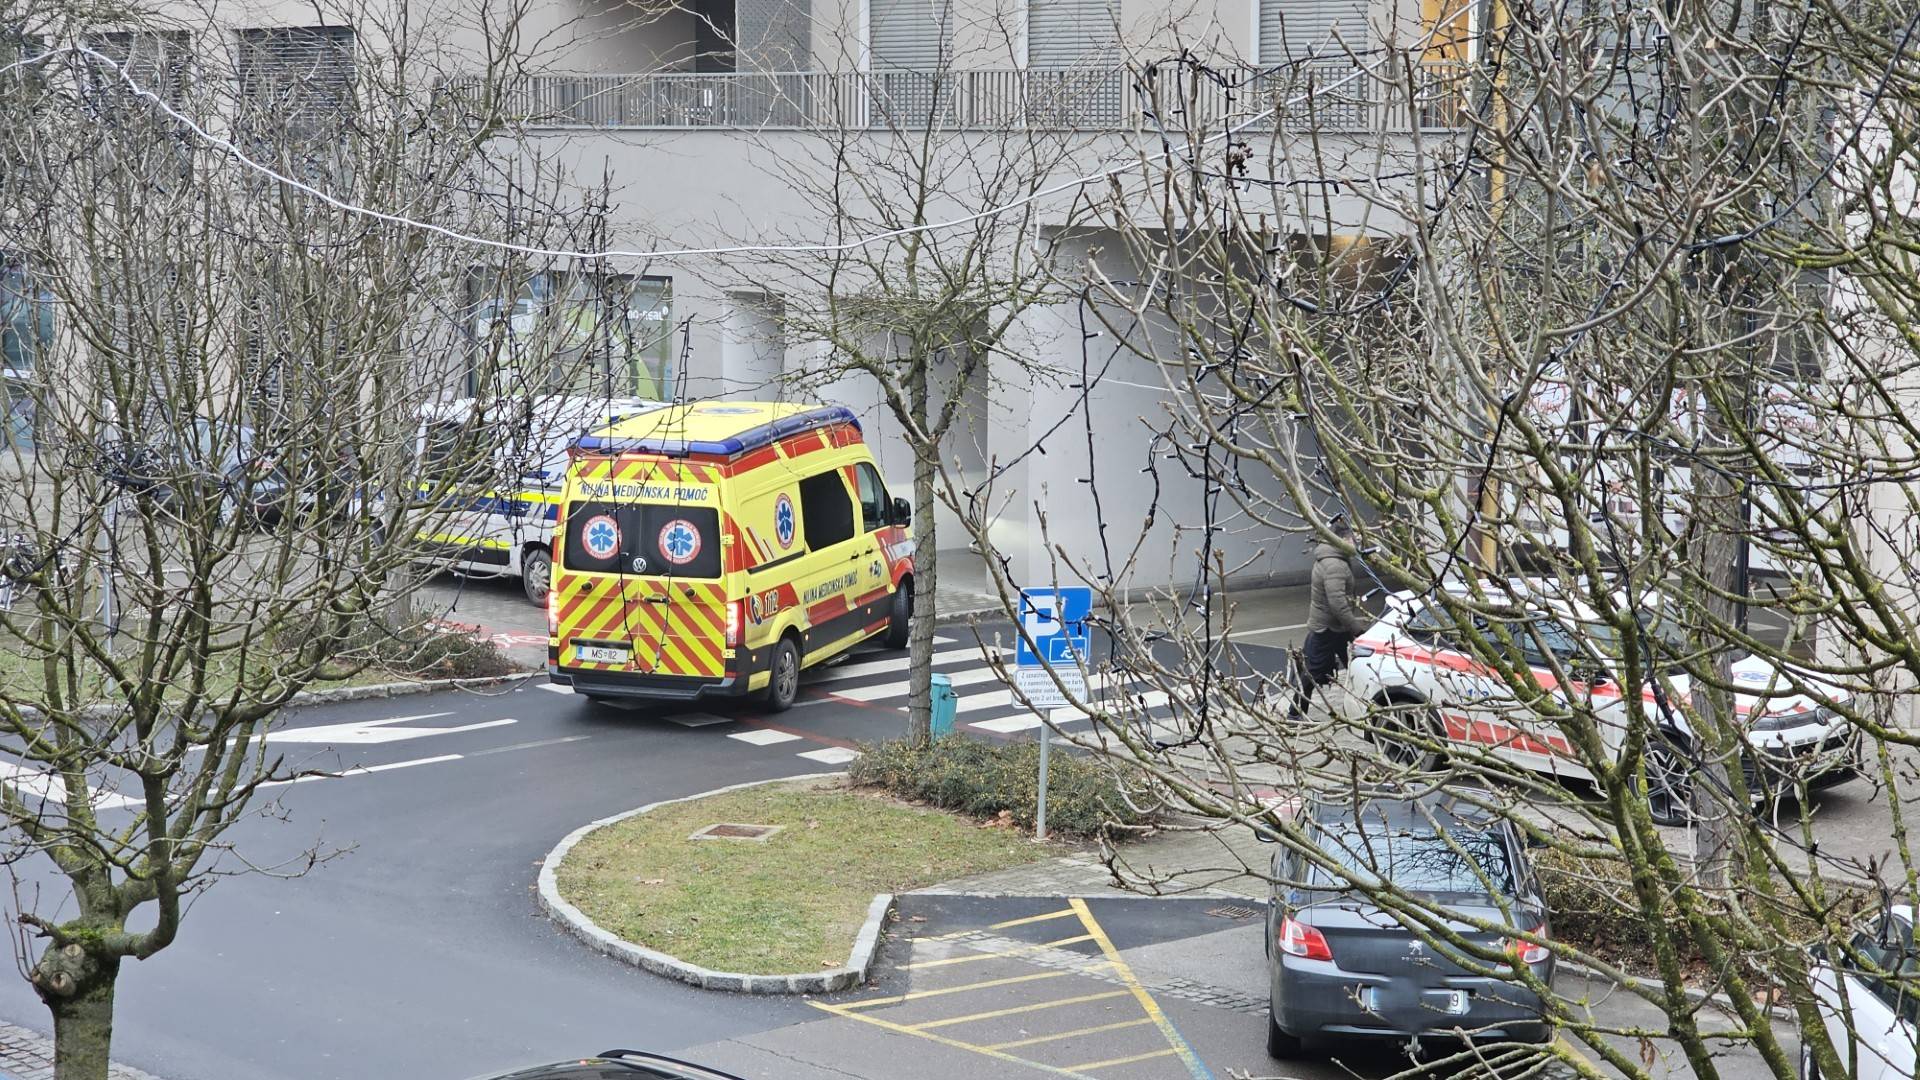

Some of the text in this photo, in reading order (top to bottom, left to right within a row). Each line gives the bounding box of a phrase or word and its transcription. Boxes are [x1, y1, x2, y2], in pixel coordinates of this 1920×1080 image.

[613, 484, 670, 499] MEDICINSKA
[765, 590, 779, 616] 112
[1024, 595, 1064, 652] P
[591, 649, 602, 659] MS
